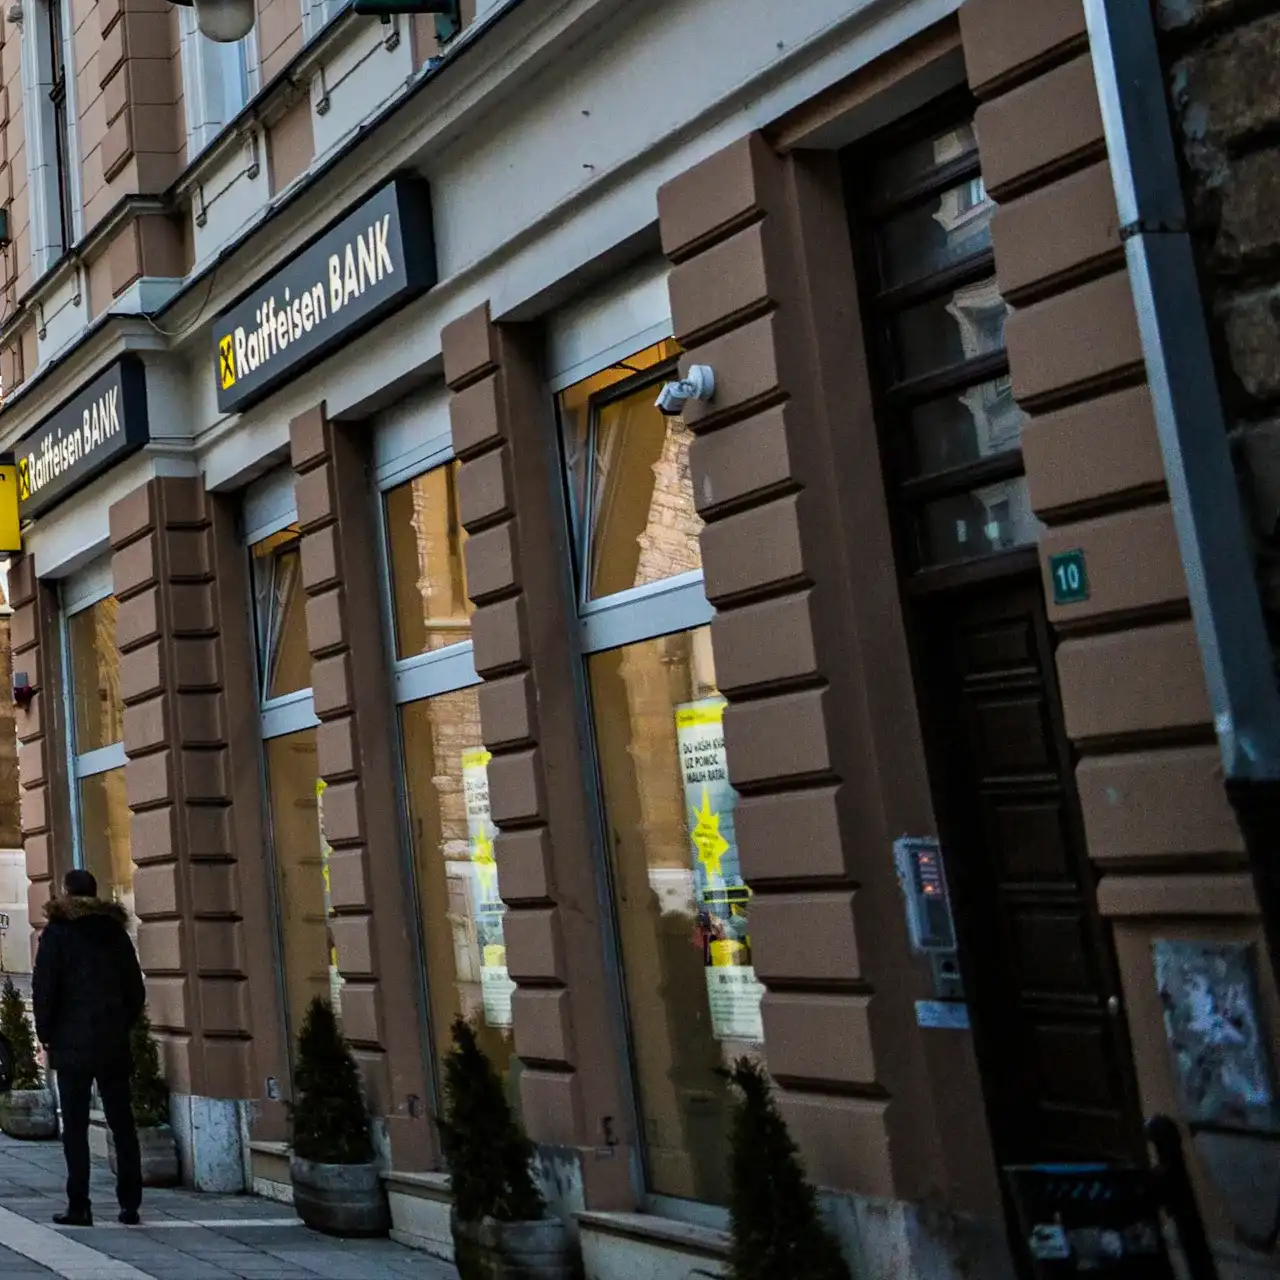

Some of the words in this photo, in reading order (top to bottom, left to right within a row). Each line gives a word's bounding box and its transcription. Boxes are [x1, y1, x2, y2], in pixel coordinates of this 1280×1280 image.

[234, 282, 327, 379] Raiffeisen
[329, 214, 394, 314] BANK
[28, 427, 83, 494] Raiffeisen
[82, 385, 120, 454] BANK
[1056, 563, 1079, 591] 10
